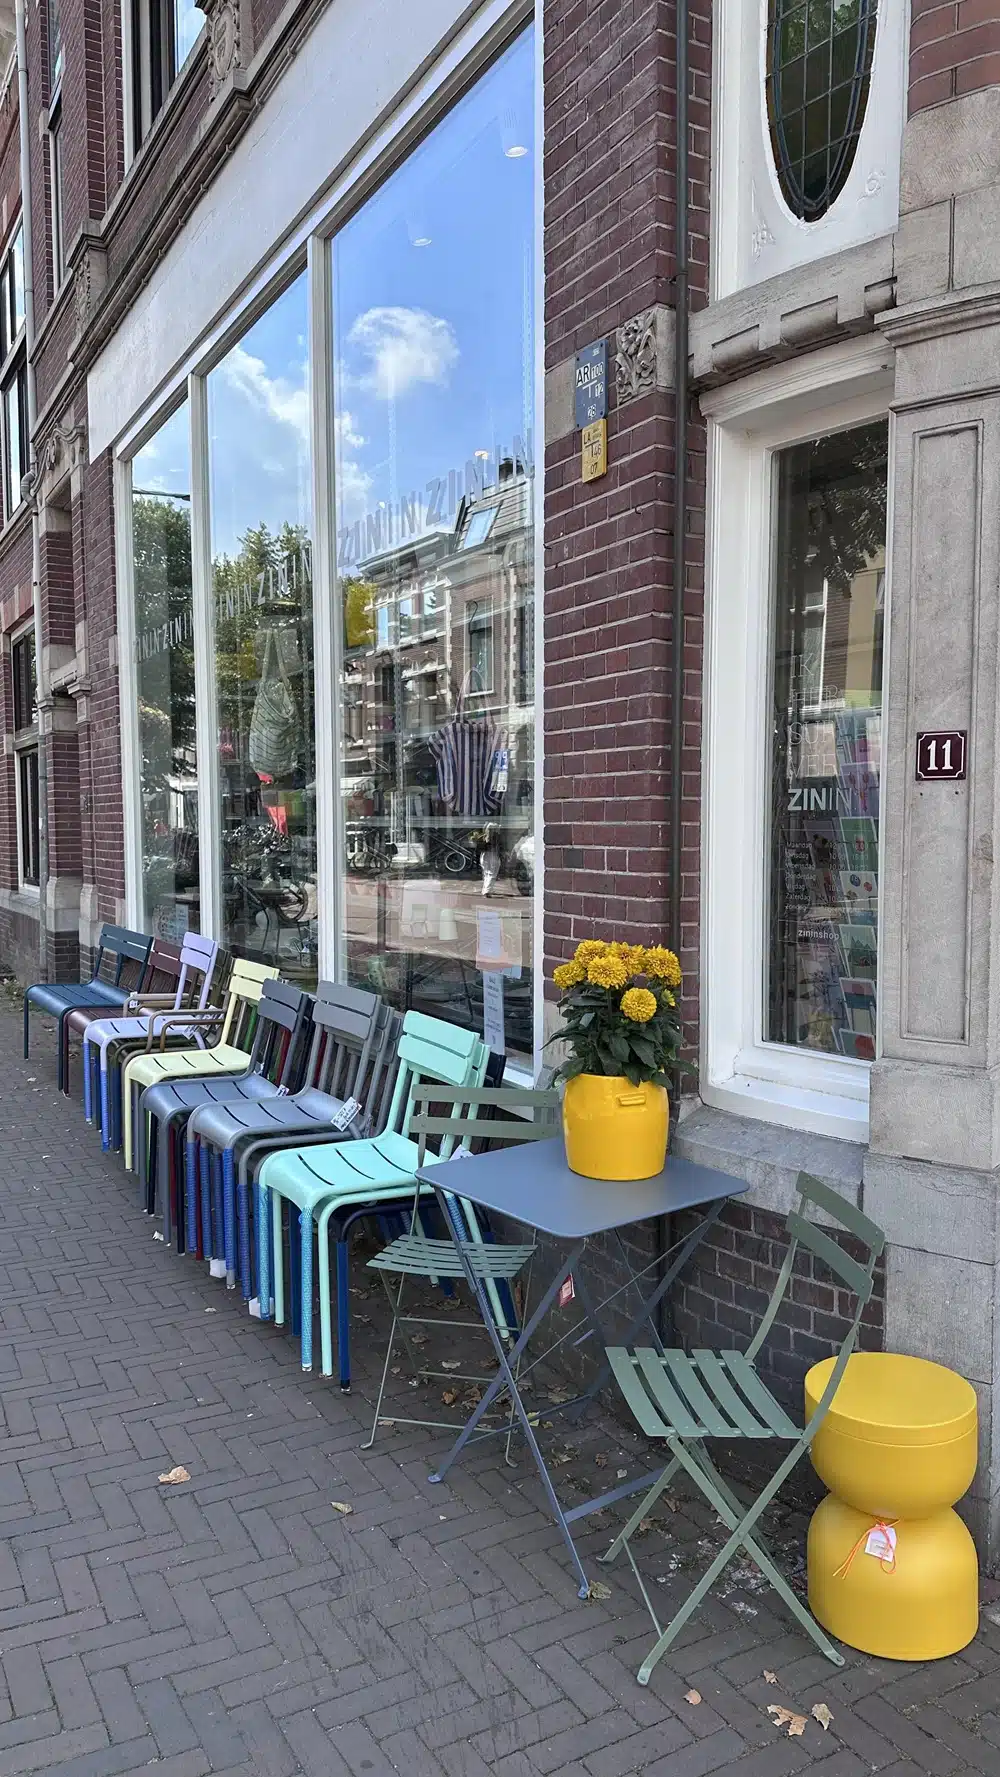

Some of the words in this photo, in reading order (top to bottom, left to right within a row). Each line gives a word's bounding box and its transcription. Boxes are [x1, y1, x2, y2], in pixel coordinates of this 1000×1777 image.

[576, 363, 591, 387] AR
[927, 739, 954, 771] 11
[787, 787, 852, 811] ZININ
